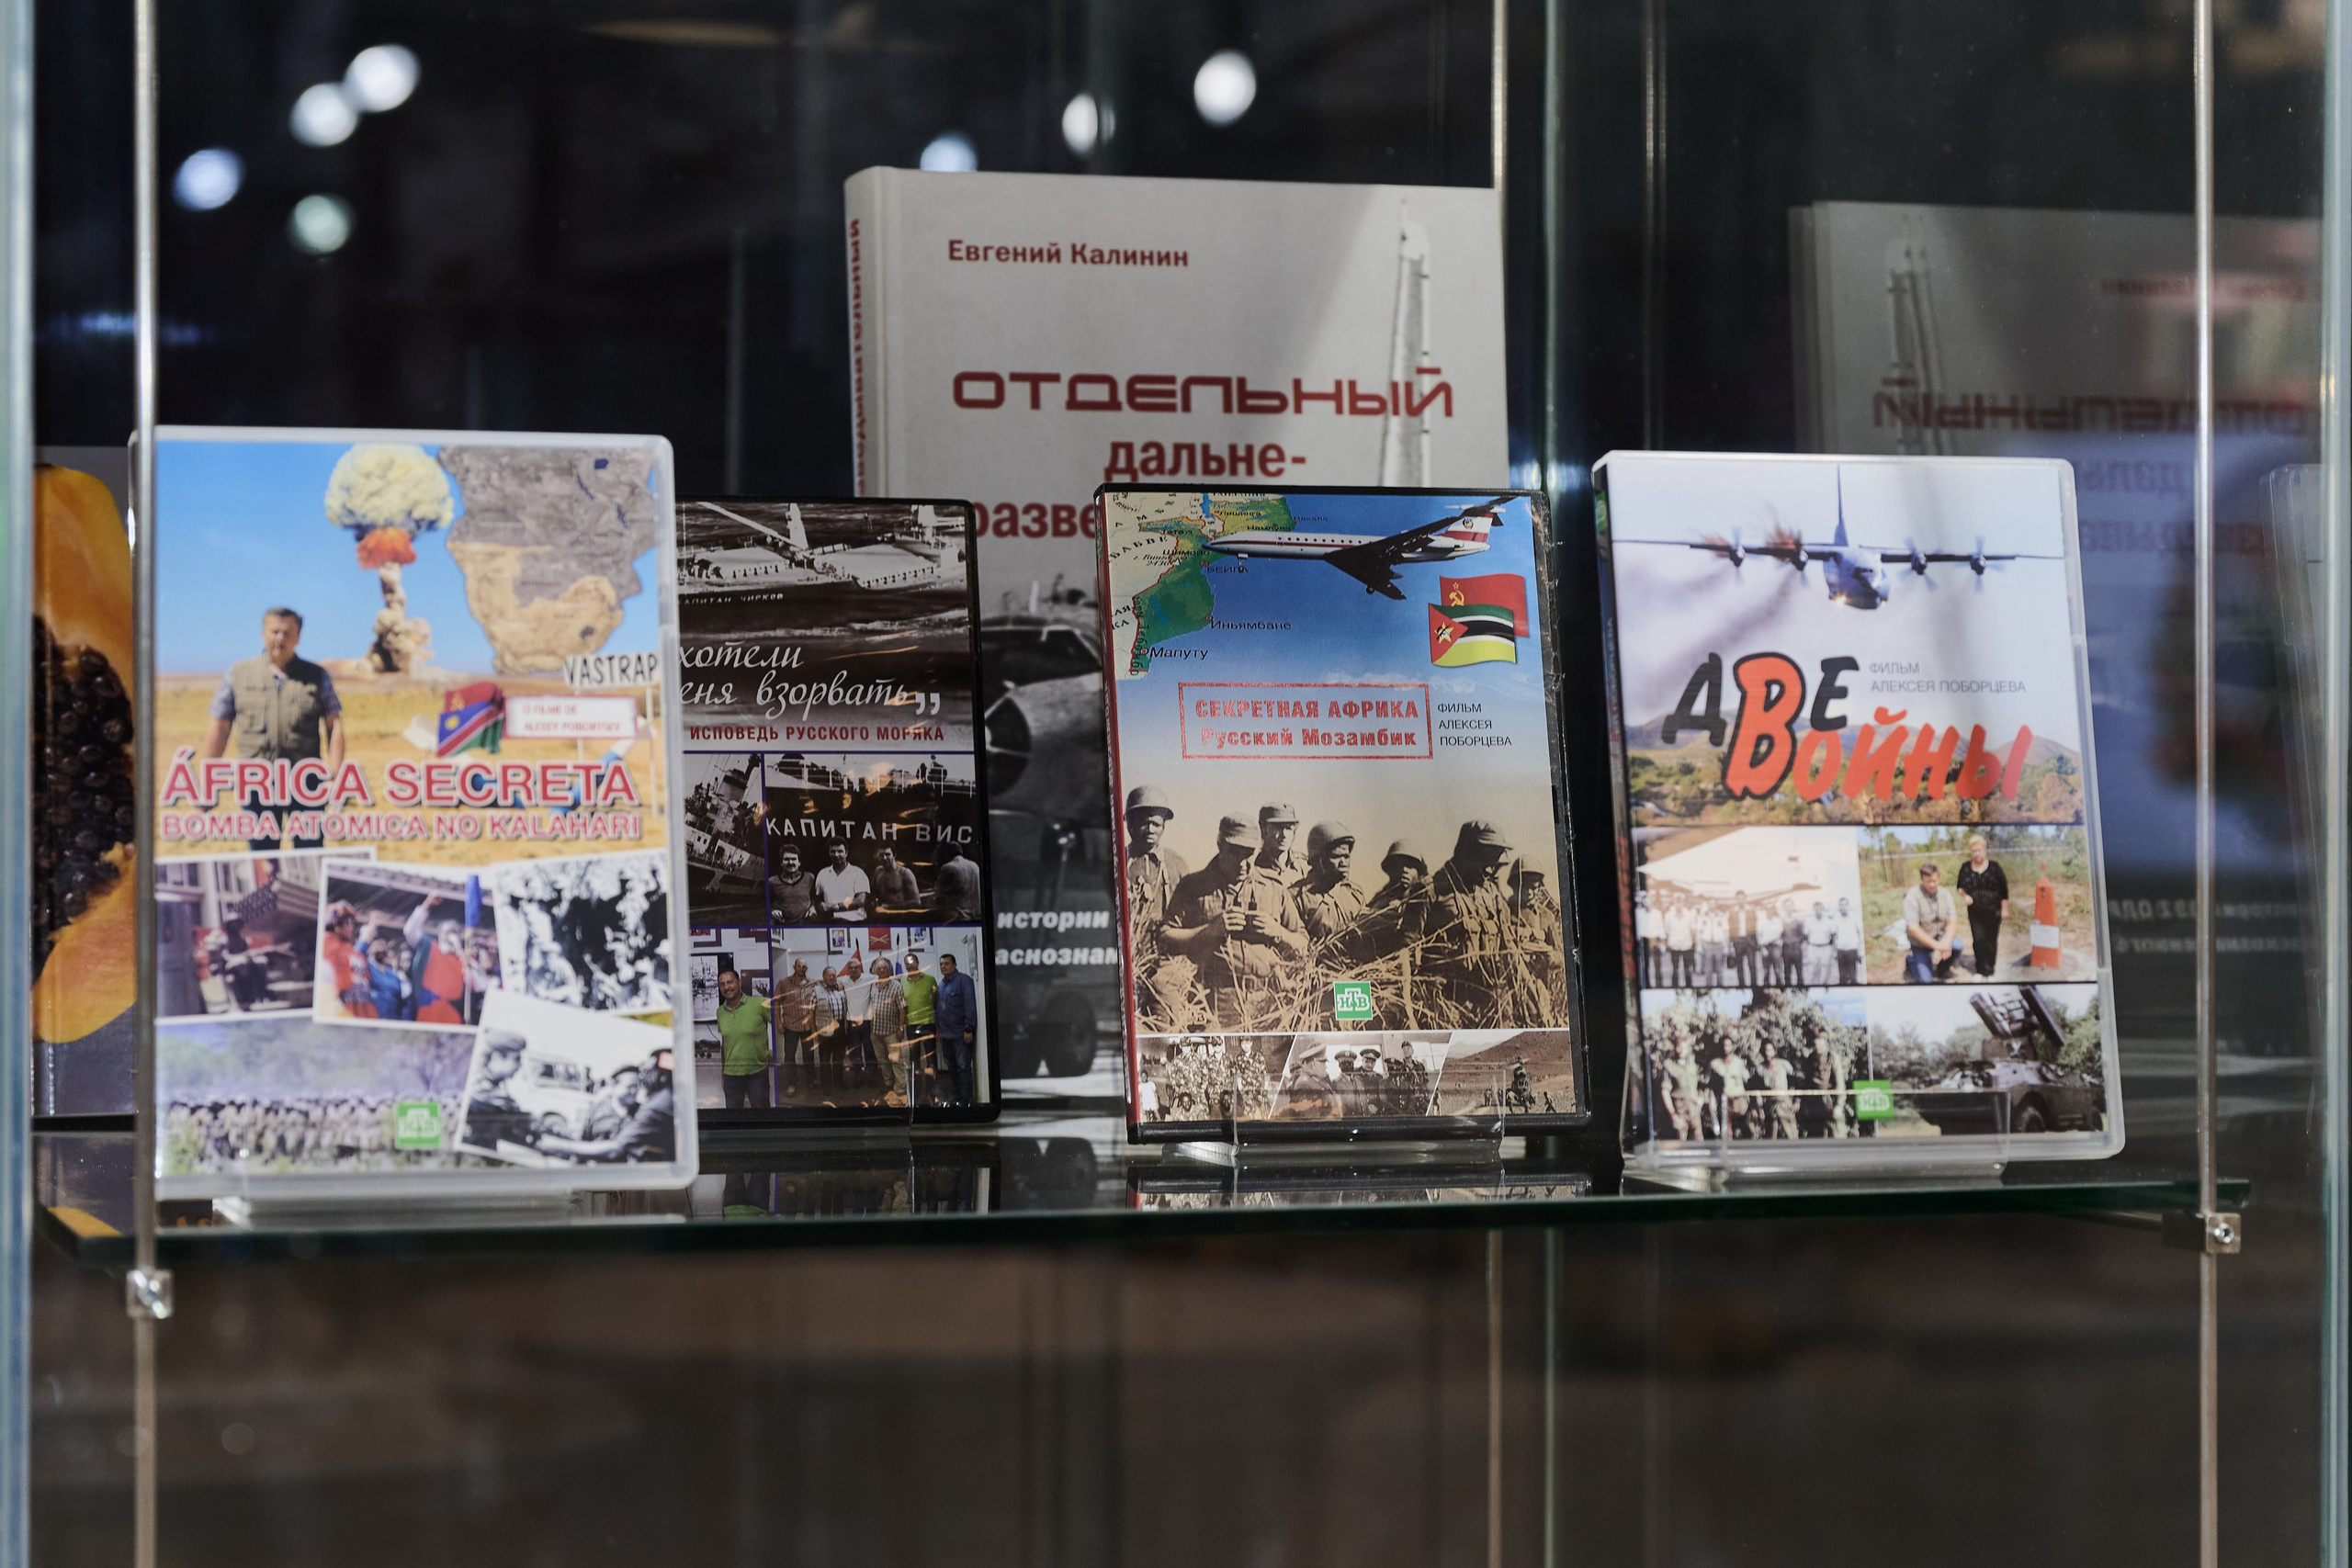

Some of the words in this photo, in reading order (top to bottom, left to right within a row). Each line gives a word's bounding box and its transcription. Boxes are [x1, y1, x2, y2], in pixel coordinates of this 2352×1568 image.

[947, 239, 1062, 264] Евгений
[1069, 243, 1190, 267] Калинин
[952, 367, 1455, 418] ОТДЕЛЬНЫЙ
[1104, 440, 1307, 483] дальне-
[677, 595, 732, 606] АПИТАН
[1209, 620, 1292, 631] Иньямбане
[679, 640, 805, 669] хотели
[1148, 646, 1209, 660] Мапуту
[563, 653, 659, 685] VASTRAP
[1870, 661, 1920, 674] ФИЛЬМ
[1871, 681, 1936, 694] АЛЕКСЕЯ
[1939, 680, 2028, 695] ПОБОРЦЕВА
[1195, 700, 1319, 718] СЕКРЕТНАЯ
[1328, 700, 1419, 718] АФРИКА
[1437, 702, 1483, 714] ФИЛЬМ
[689, 726, 779, 742] ИСПОВЕДЬ
[786, 726, 869, 741] РУССКОГО
[876, 727, 944, 741] МОРЯКА
[1438, 719, 1493, 730] АЛЕКСЕЯ
[1201, 728, 1294, 750] Русский
[1301, 728, 1418, 747] Мозамбик
[1440, 736, 1512, 749] ПОБОРЦЕВА
[161, 746, 372, 807] ÁFRICA
[386, 760, 640, 807] SECRETA
[162, 812, 278, 840] BOMBA
[281, 808, 427, 840] ATÓMICA
[435, 812, 481, 840] NO
[490, 812, 641, 840] KALAHARI
[765, 818, 898, 840] КАПИТАН
[916, 824, 973, 843] ВИС
[997, 910, 1110, 932] истории
[1337, 987, 1370, 1011] НТВ
